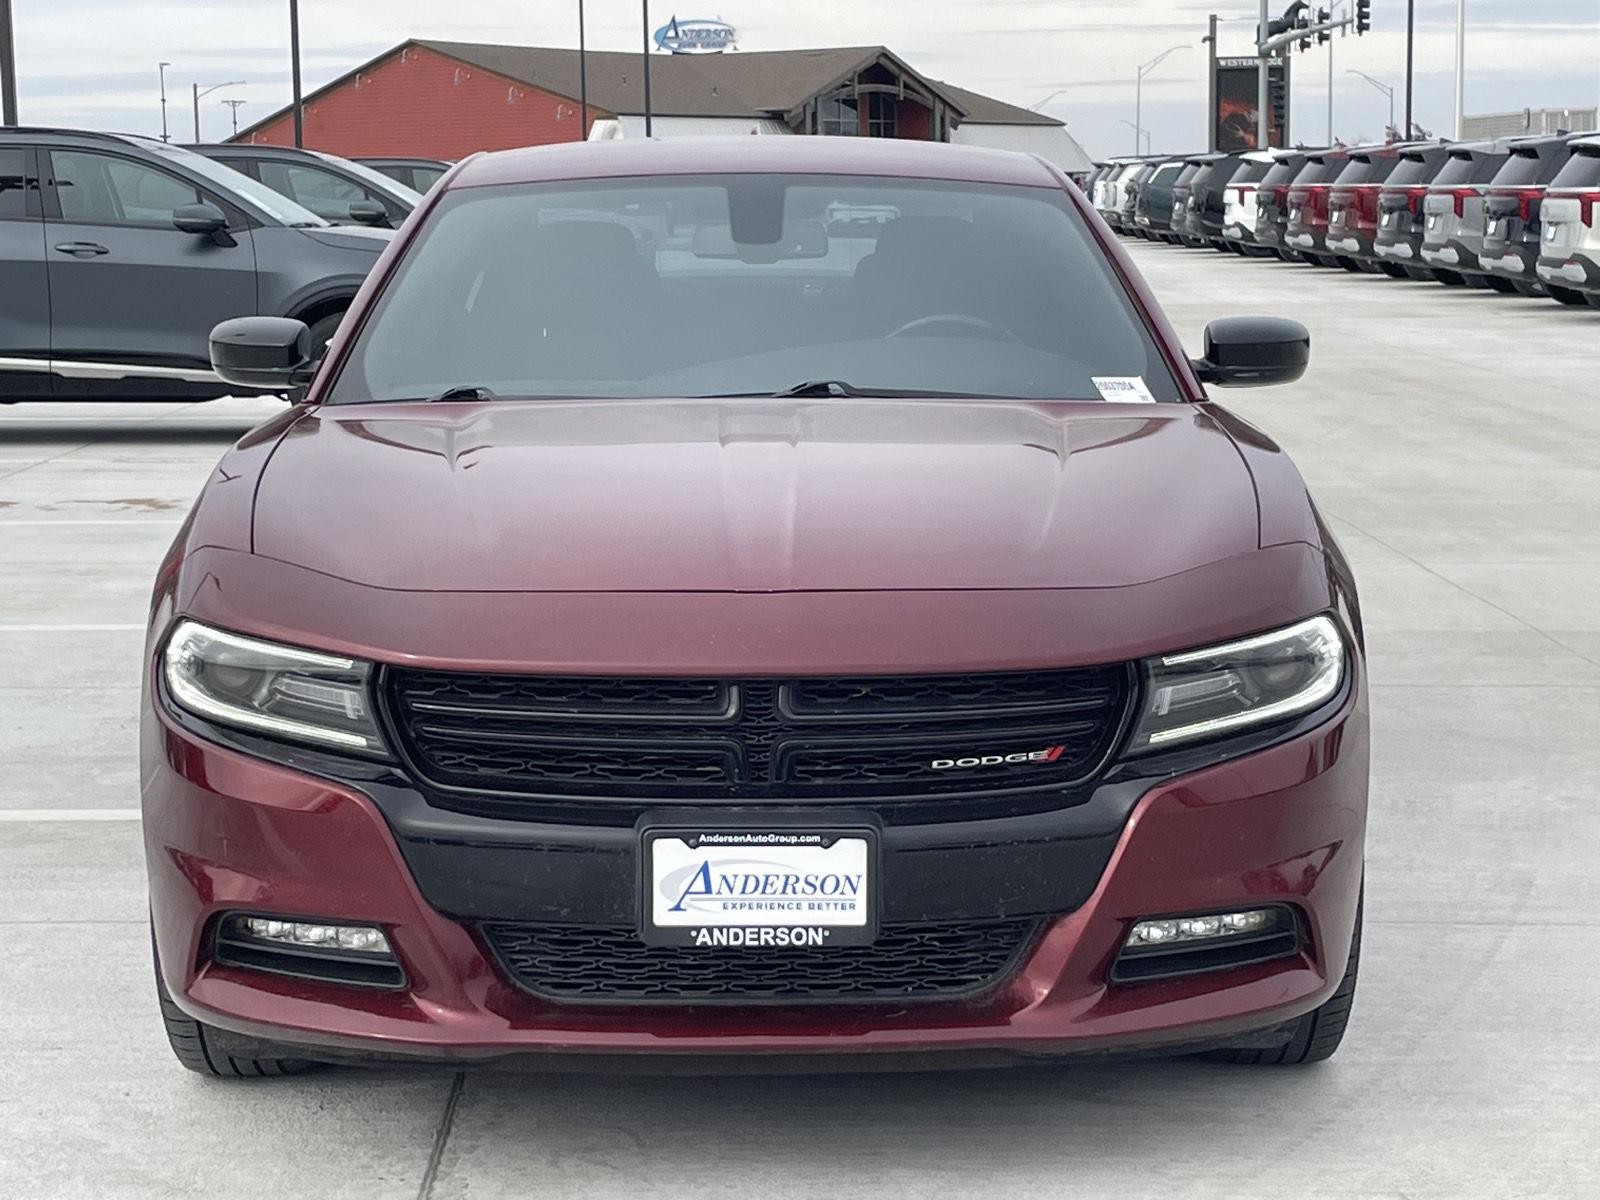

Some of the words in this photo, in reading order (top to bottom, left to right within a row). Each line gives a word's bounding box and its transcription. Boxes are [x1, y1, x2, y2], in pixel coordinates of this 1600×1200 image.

[656, 14, 734, 51] ANDERSON
[931, 749, 1049, 769] DODGE
[698, 833, 821, 844] AndersonAutoGroup.com
[667, 859, 863, 912] ANDERSON
[722, 902, 803, 911] EXPERIENCE
[808, 902, 857, 911] BETTER
[695, 927, 824, 946] ANDERSON
